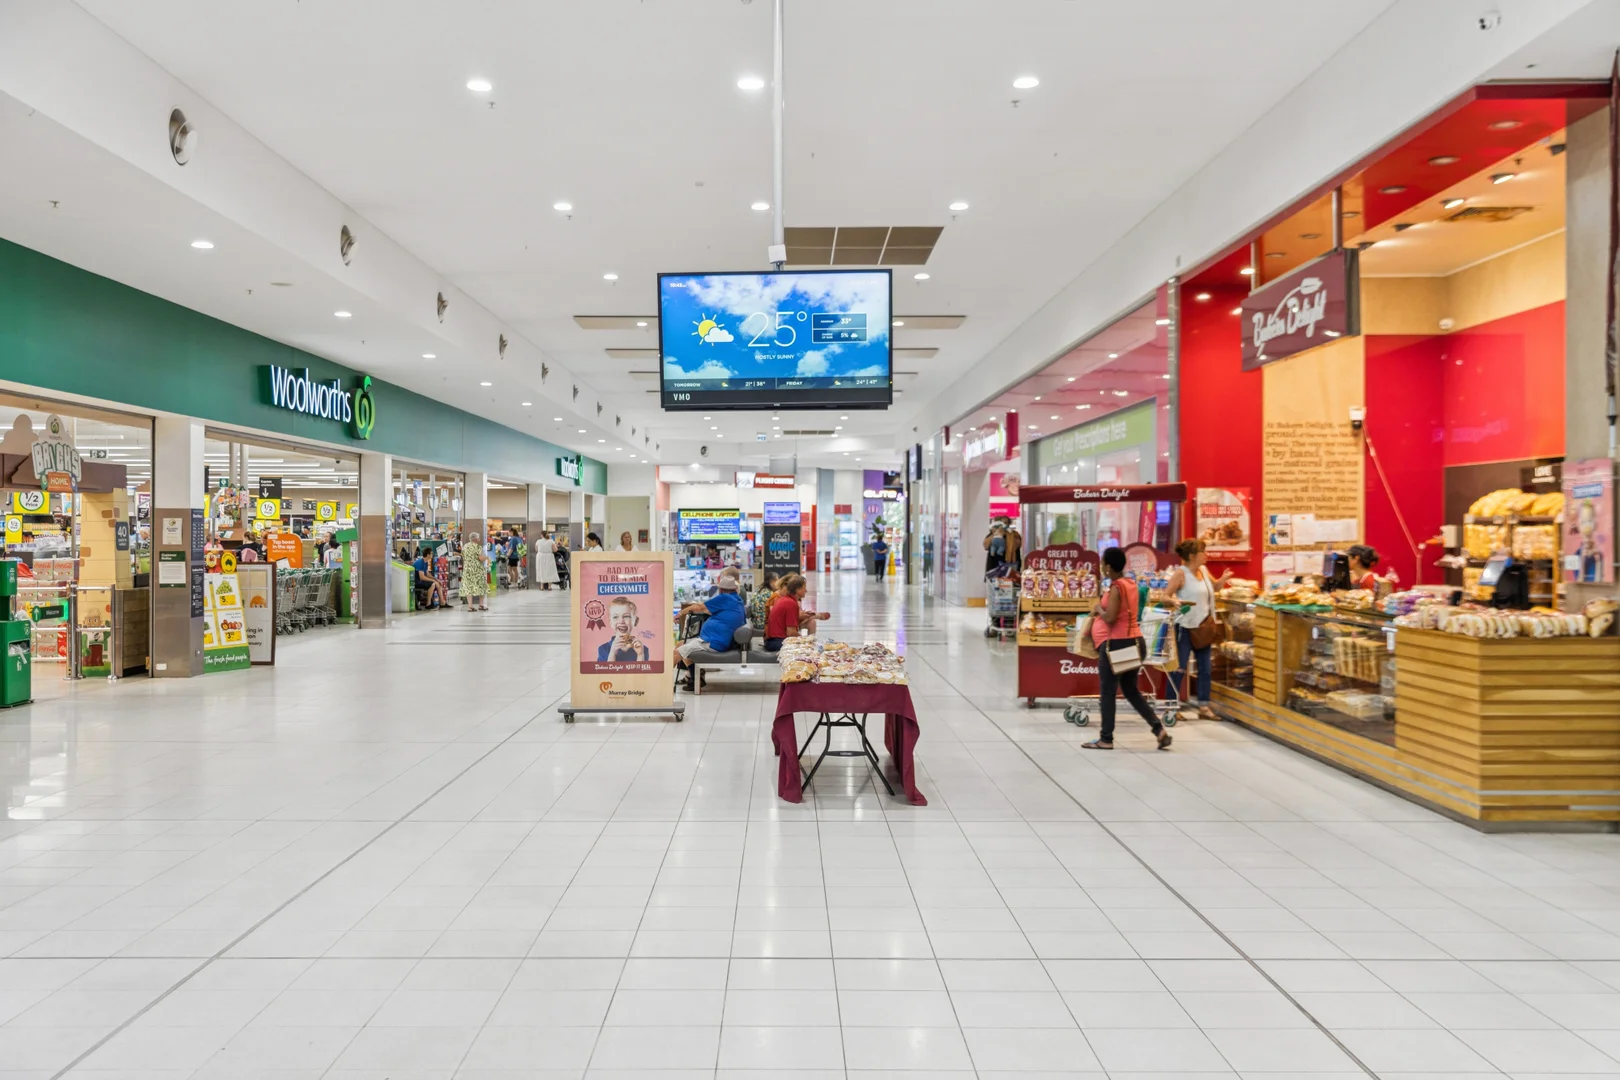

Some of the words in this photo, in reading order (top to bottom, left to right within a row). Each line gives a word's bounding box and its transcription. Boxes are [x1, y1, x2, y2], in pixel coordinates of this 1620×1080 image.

[1286, 290, 1327, 338] Delight
[270, 364, 351, 423] Woolworths
[1265, 430, 1296, 440] proud
[1272, 448, 1285, 460] by
[1283, 459, 1321, 467] natural
[1326, 460, 1358, 469] grains
[24, 492, 39, 502] 1/2
[1073, 488, 1100, 499] Bakers
[1100, 488, 1130, 501] Delight
[118, 526, 126, 537] 40
[769, 542, 796, 551] MAGIC
[1032, 558, 1062, 570] GRAB
[1064, 560, 1073, 571] &
[600, 584, 647, 593] CHEESYMITE
[204, 654, 213, 664] The
[213, 655, 225, 665] fresh
[226, 654, 235, 663] food
[235, 653, 247, 662] people
[1060, 660, 1099, 674] Bakers
